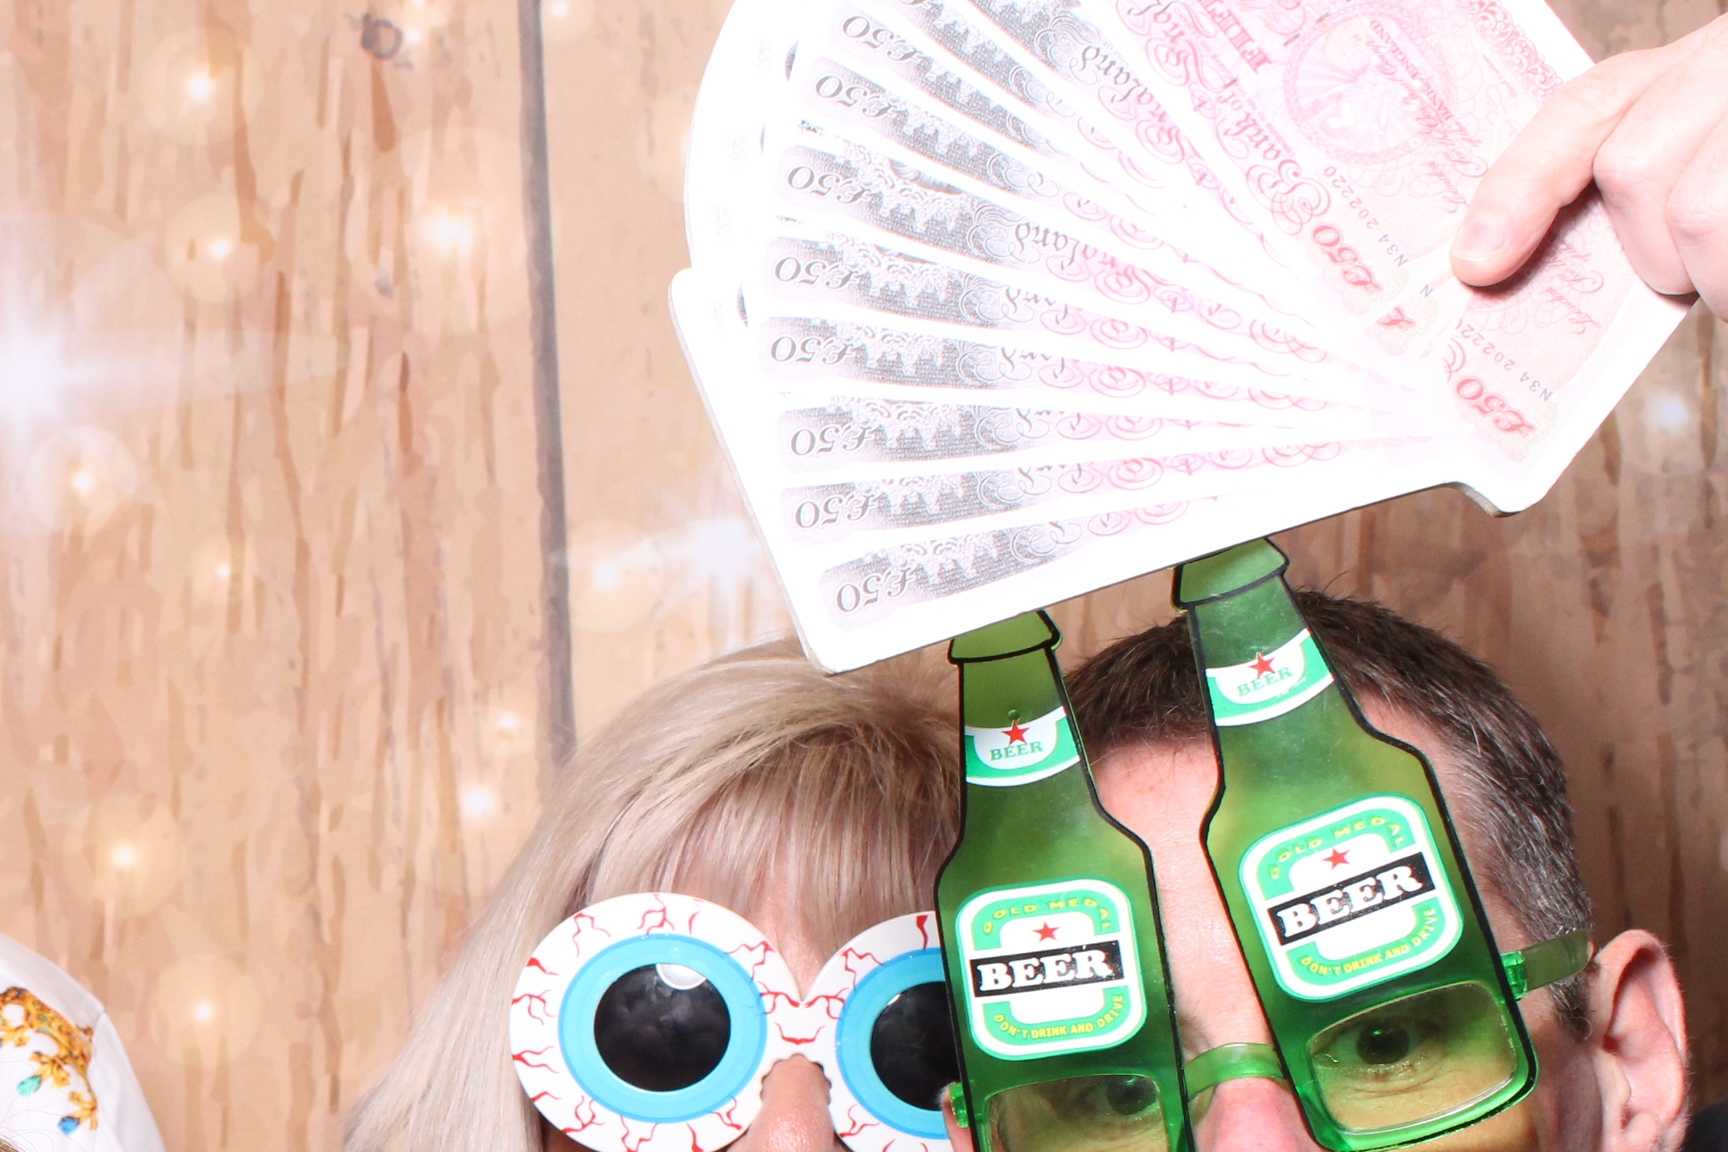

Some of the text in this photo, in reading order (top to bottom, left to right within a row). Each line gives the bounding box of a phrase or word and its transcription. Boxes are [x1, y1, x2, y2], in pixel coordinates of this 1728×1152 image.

[842, 15, 924, 62] £50
[1368, 19, 1420, 79] ENGLAND
[814, 74, 899, 119] £50
[785, 164, 874, 205] £50
[1218, 117, 1331, 236] Bank
[1323, 165, 1379, 229] 202220
[1312, 224, 1383, 293] £50
[1378, 232, 1409, 267] N34
[773, 255, 863, 290] £50
[769, 335, 857, 365] £50
[1455, 377, 1536, 438] £50
[1518, 370, 1553, 401] N34
[789, 422, 879, 456] £50
[794, 490, 883, 529] £50
[834, 564, 918, 613] £50
[1235, 666, 1294, 698] BEER
[990, 741, 1044, 761] BEER
[1267, 816, 1405, 880] GOLD MEDAL
[983, 897, 1112, 935] GOLD MEDAL
[1276, 865, 1424, 938] BEER
[1299, 907, 1438, 976] DON'T DRINK AND DRIVE
[976, 949, 1114, 993] BEER
[992, 994, 1125, 1039] DON'T DRINK AND DRIVE
